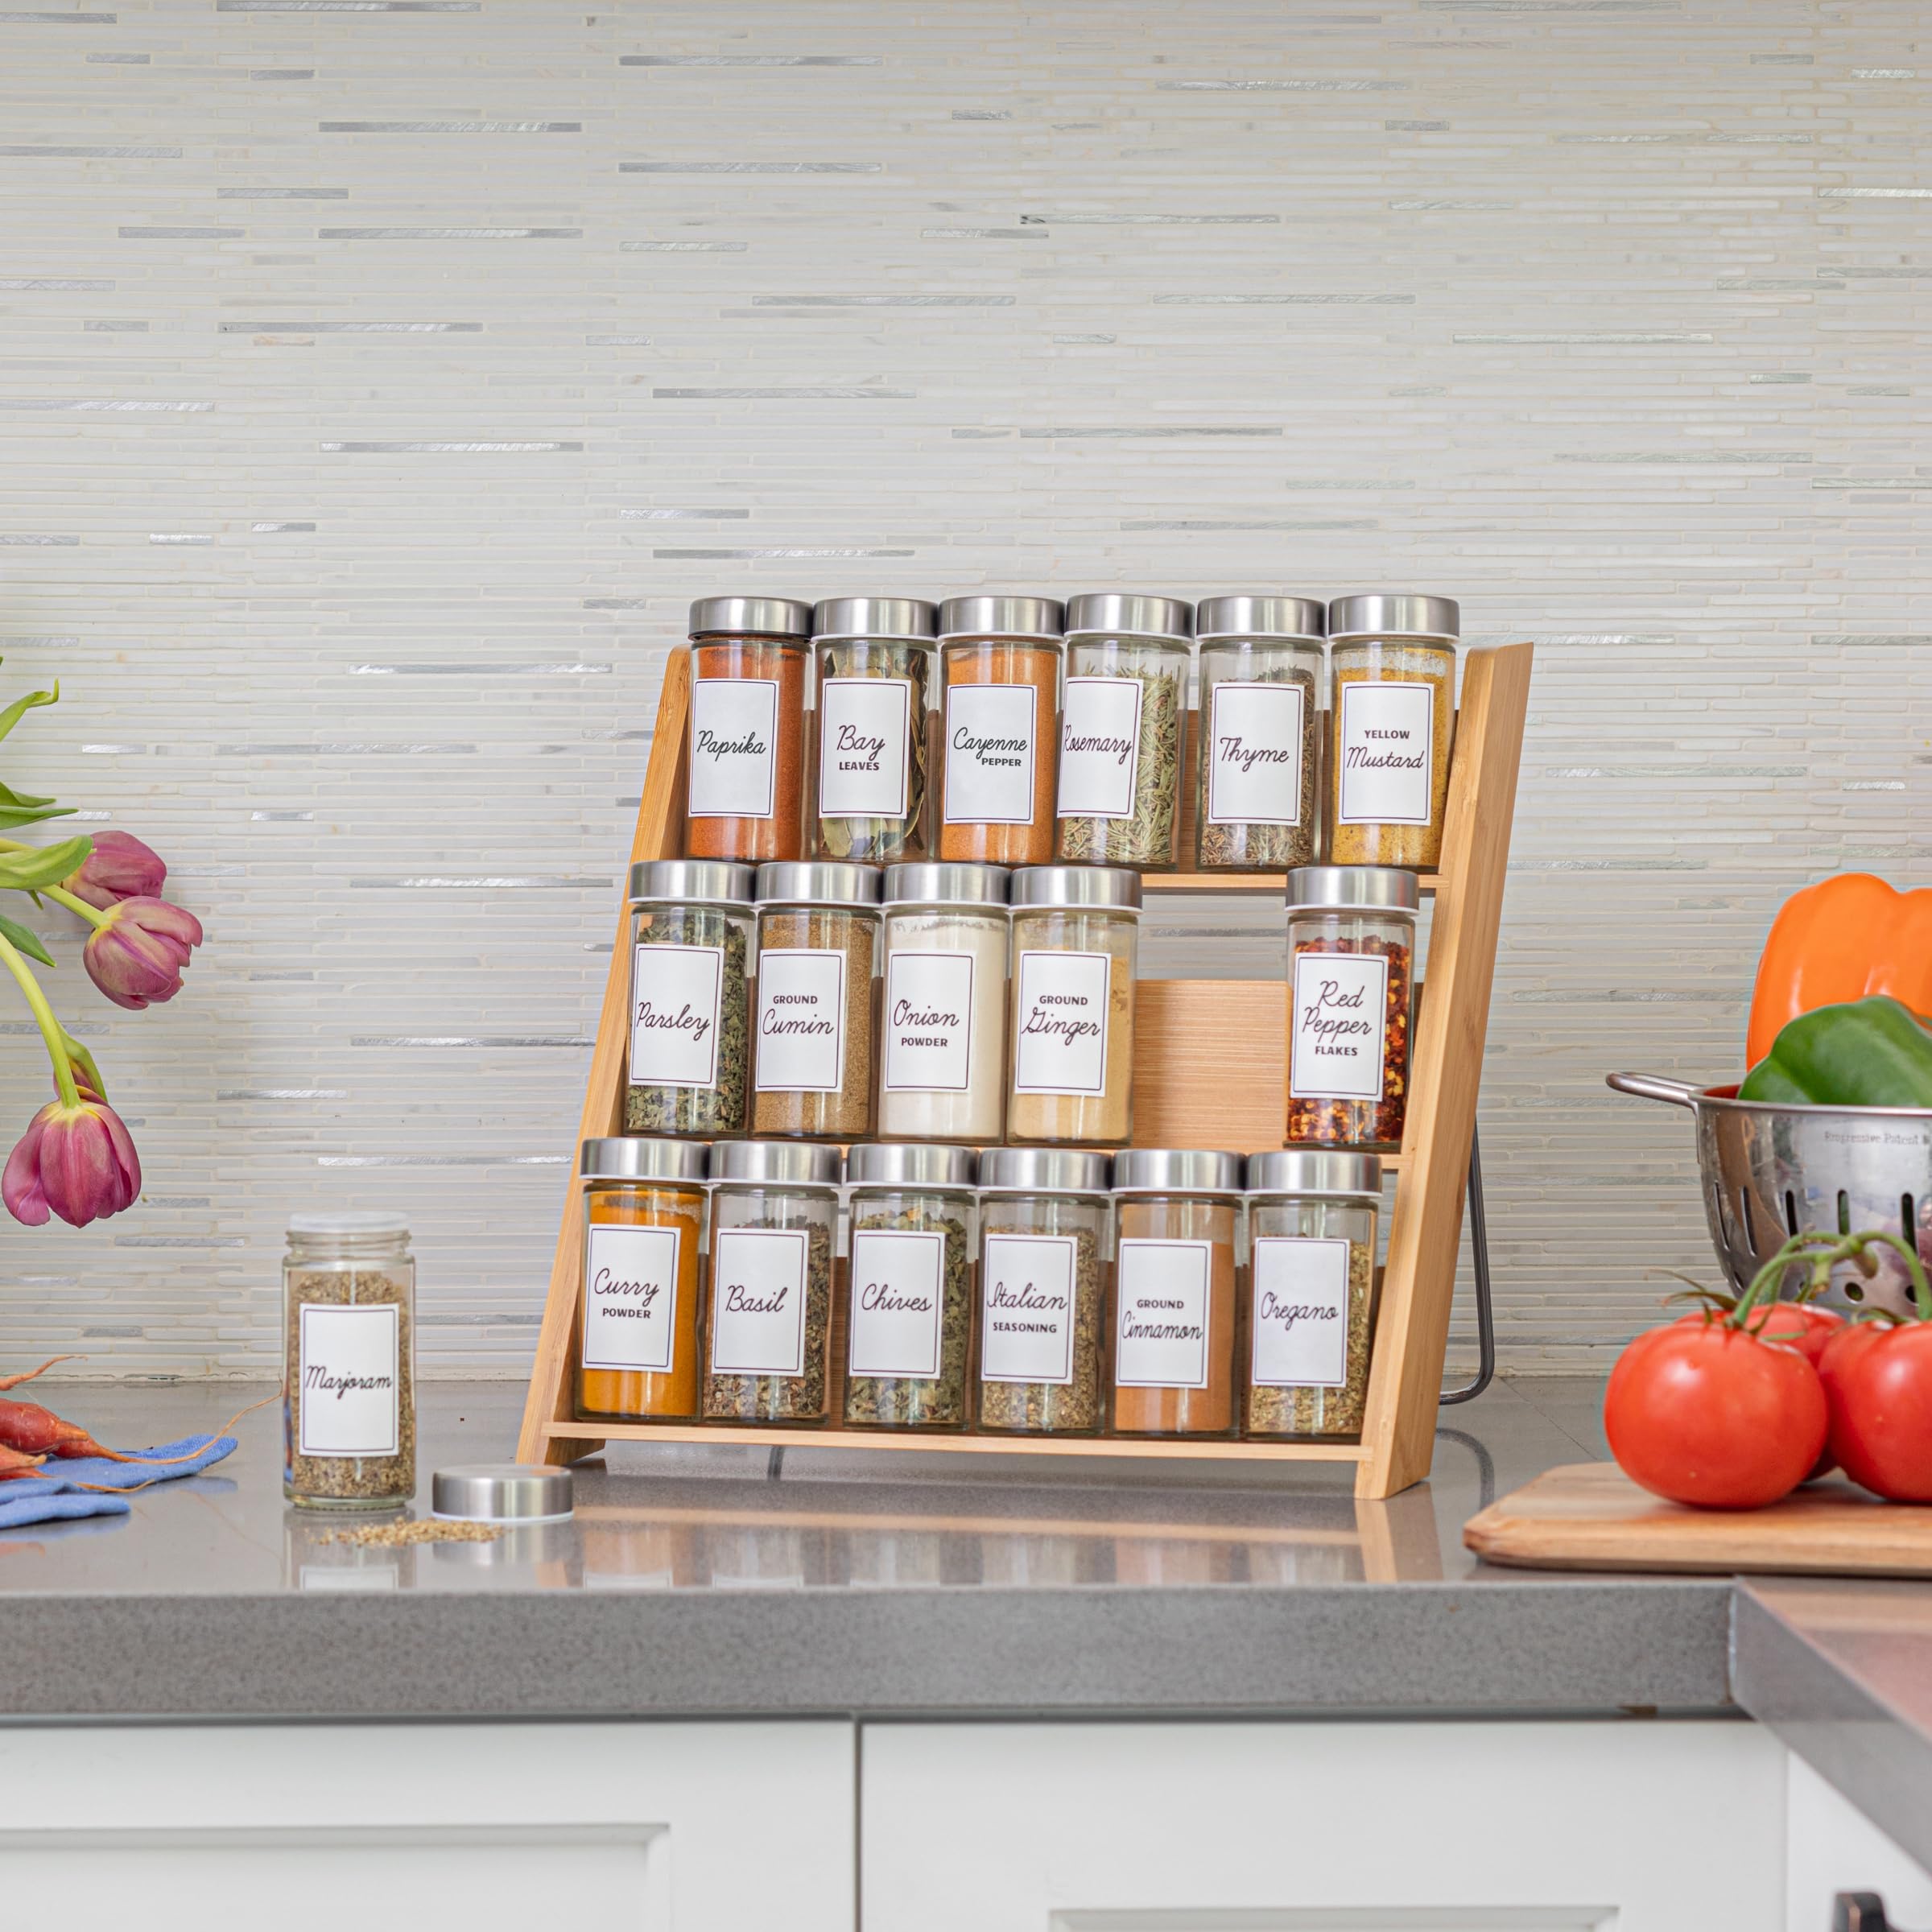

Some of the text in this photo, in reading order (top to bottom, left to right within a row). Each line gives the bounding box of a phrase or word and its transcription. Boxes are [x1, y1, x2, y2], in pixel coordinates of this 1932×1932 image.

[696, 730, 767, 762] Paprika
[836, 724, 886, 762] Bay
[953, 727, 1027, 760] Cayenne
[1364, 729, 1410, 740] YELLOW
[839, 761, 880, 771] LEAVES
[981, 757, 1022, 767] PEPPER
[1220, 737, 1290, 772] Thyme
[1346, 746, 1423, 769] Mustard
[773, 995, 818, 1005] GROUND
[1039, 995, 1089, 1006] GROUND
[1317, 980, 1366, 1009] Red
[636, 1002, 711, 1042] Parsley
[762, 1009, 834, 1035] Cumin
[893, 999, 960, 1027] Onion
[1021, 1007, 1101, 1046] Ginger
[1302, 1007, 1373, 1043] Pepper
[901, 1038, 948, 1047] POWDER
[1315, 1046, 1358, 1057] FLAKES
[593, 1268, 659, 1307] Curry
[725, 1285, 789, 1313] Basil
[861, 1283, 932, 1311] Chives
[986, 1282, 1067, 1311] Italian
[602, 1307, 651, 1319] POWDER
[1137, 1298, 1184, 1310] GROUND
[1261, 1291, 1339, 1331] Oregano
[993, 1322, 1058, 1334] SEASONING
[1122, 1311, 1203, 1341] Cinnamon
[305, 1365, 393, 1400] Marjoram
